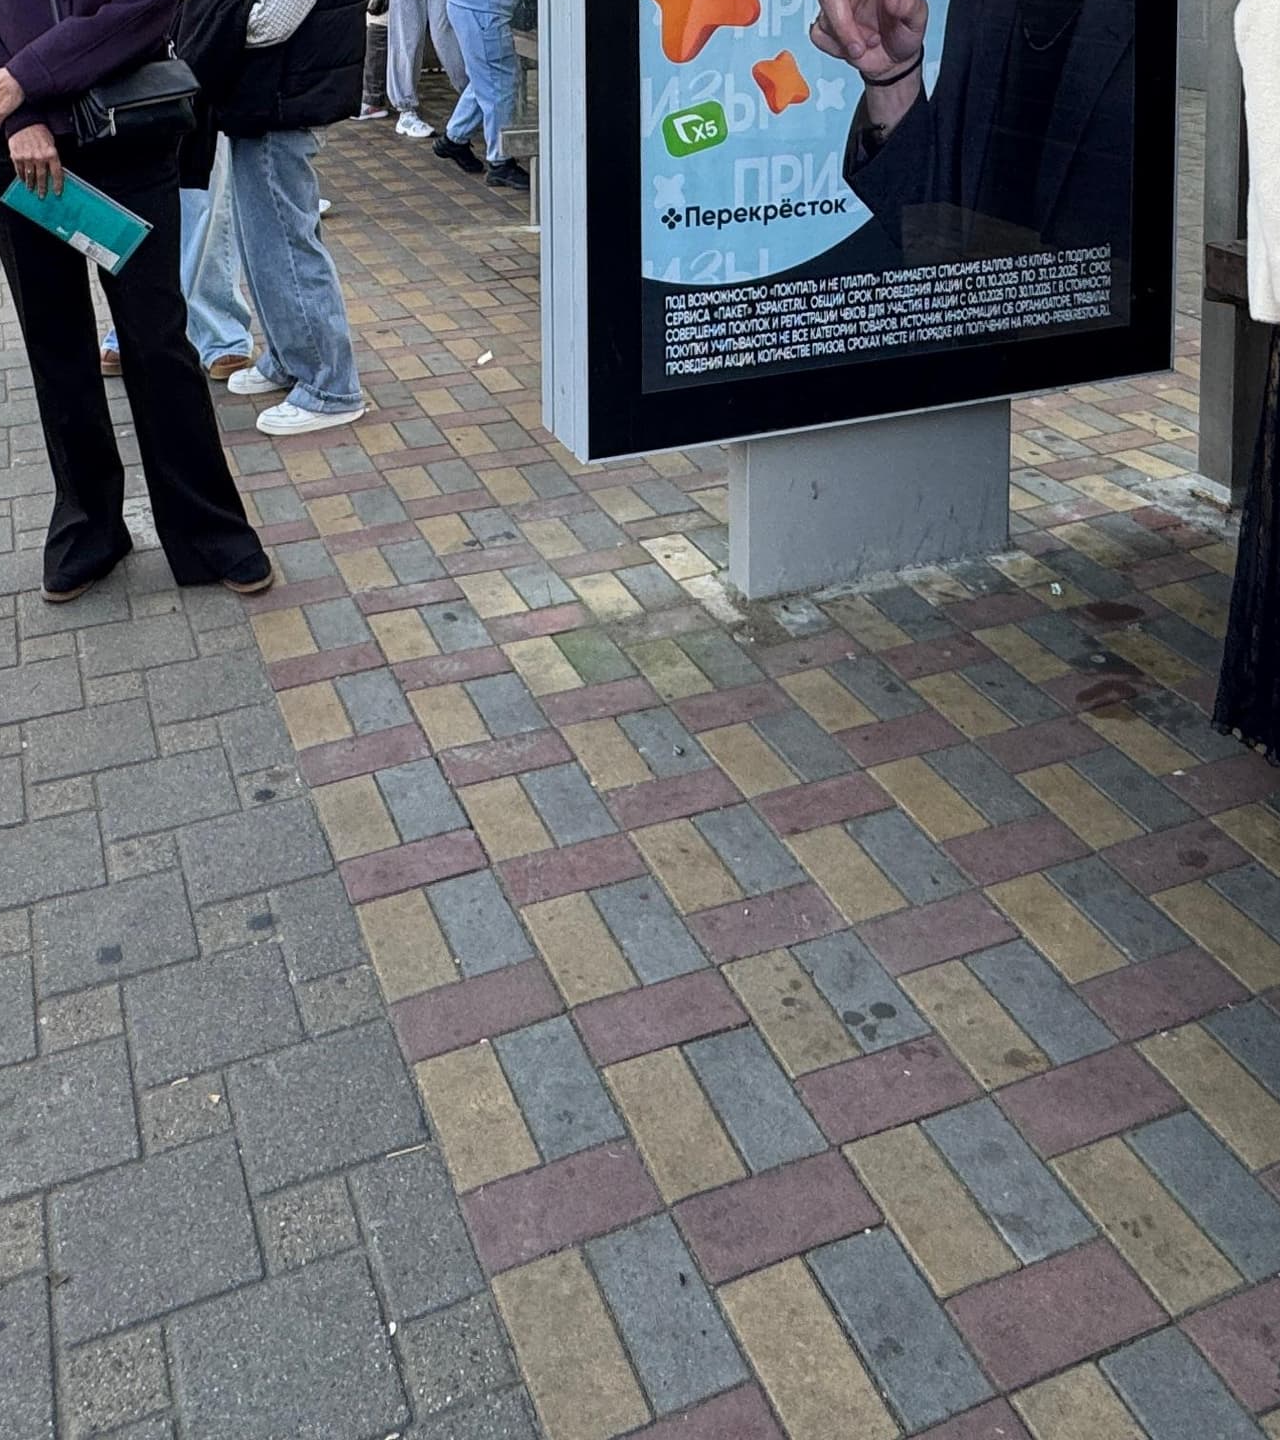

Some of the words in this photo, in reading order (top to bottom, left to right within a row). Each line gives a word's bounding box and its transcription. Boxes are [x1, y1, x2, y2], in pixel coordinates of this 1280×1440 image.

[692, 118, 719, 144] X5
[684, 197, 847, 232] Перекрёсток
[665, 294, 685, 311] ПОД
[688, 285, 766, 306] ВОЗМОЖНОСТЬЮ
[769, 280, 817, 297] «ПОКУПАТЬ
[820, 279, 826, 291] И
[828, 278, 838, 290] НЕ
[840, 273, 880, 289] ПЛАТИТЬ»
[882, 267, 936, 284] ПОНИМАЕТСЯ
[938, 262, 980, 278] СПИСАНИЕ
[982, 258, 1012, 273] БАЛЛОВ
[1058, 253, 1063, 264] С
[1065, 244, 1110, 265] ПОДПИСКОЙ
[665, 307, 710, 325] СЕРВИСА
[713, 302, 752, 320] «ПАКЕТ»
[810, 288, 844, 310] ОБЩИЙ
[847, 289, 872, 304] СРОК
[875, 282, 930, 303] ПРОВЕДЕНИЯ
[934, 278, 962, 296] АКЦИИ
[965, 277, 972, 290] С
[976, 272, 1018, 288] 01.10.2025
[1021, 270, 1035, 283] ПО
[1038, 265, 1077, 281] 31.12.2025
[1089, 261, 1110, 275] СРОК
[665, 322, 726, 342] СОВЕРШЕНИЯ
[728, 317, 769, 334] ПОКУПОК
[772, 315, 778, 329] И
[780, 308, 837, 330] РЕГИСТРАЦИИ
[840, 305, 866, 320] ЧЕКОВ
[868, 303, 884, 319] ДЛЯ
[886, 298, 922, 315] УЧАСТИЯ
[924, 297, 930, 310] В
[931, 294, 958, 311] АКЦИИ
[960, 293, 966, 305] С
[1005, 287, 1016, 300] ПО
[1058, 281, 1063, 293] В
[665, 340, 708, 358] ПОКУПКИ
[710, 332, 776, 353] УЧИТЫВАЮТСЯ
[779, 330, 790, 344] НЕ
[792, 328, 808, 342] ВСЕ
[810, 322, 856, 340] КАТЕГОРИИ
[900, 311, 942, 328] ИСТОЧНИК
[944, 304, 1000, 324] ИНФОРМАЦИИ
[1002, 302, 1013, 315] ОБ
[665, 355, 722, 377] ПРОВЕДЕНИЯ
[847, 334, 880, 350] СРОКАХ
[882, 331, 907, 346] МЕСТЕ
[909, 330, 914, 342] И
[916, 325, 952, 343] ПОРЯДКЕ
[1010, 316, 1020, 328] НА
